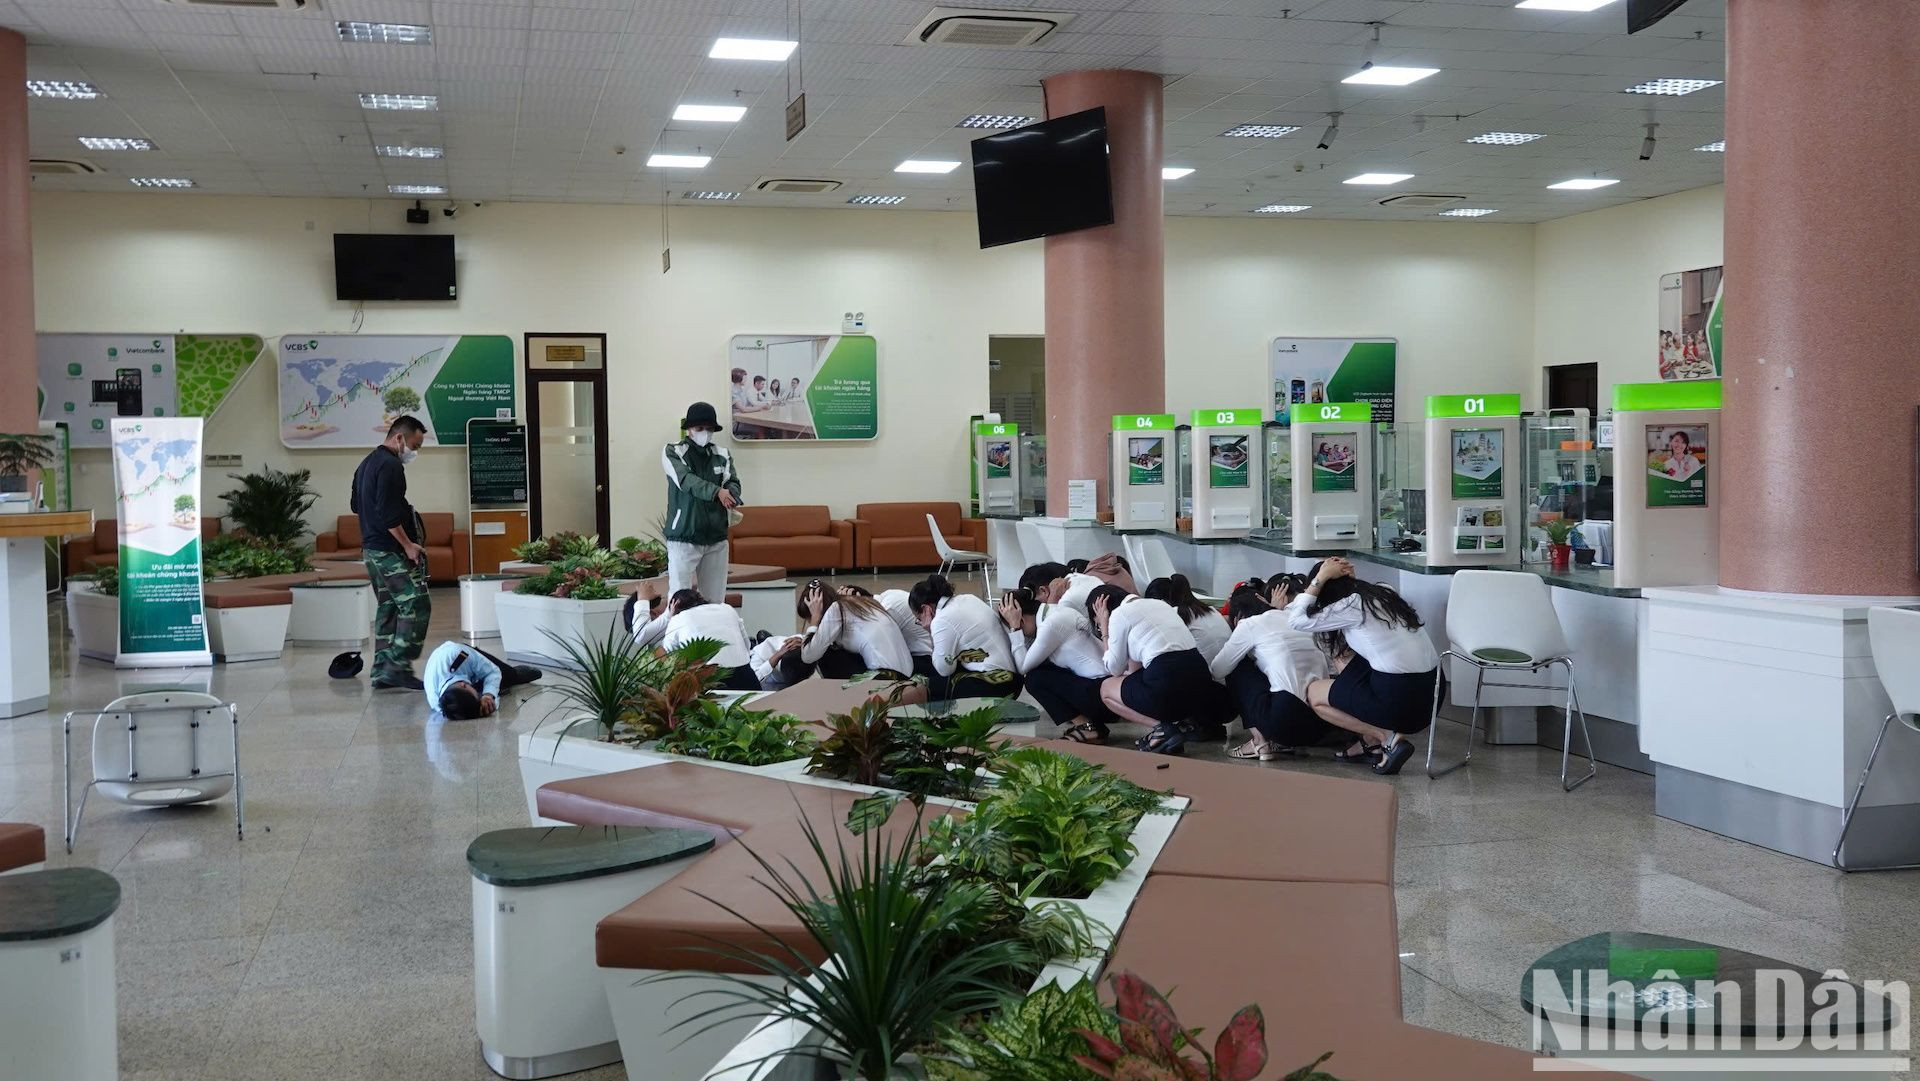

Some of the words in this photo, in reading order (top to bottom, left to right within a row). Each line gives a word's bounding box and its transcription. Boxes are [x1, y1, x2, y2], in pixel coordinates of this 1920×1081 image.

[285, 343, 308, 351] VCBS
[1464, 398, 1485, 413] 01
[1217, 412, 1235, 424] 03
[1320, 406, 1341, 419] 02
[1136, 417, 1153, 427] 04
[993, 425, 1005, 434] 06
